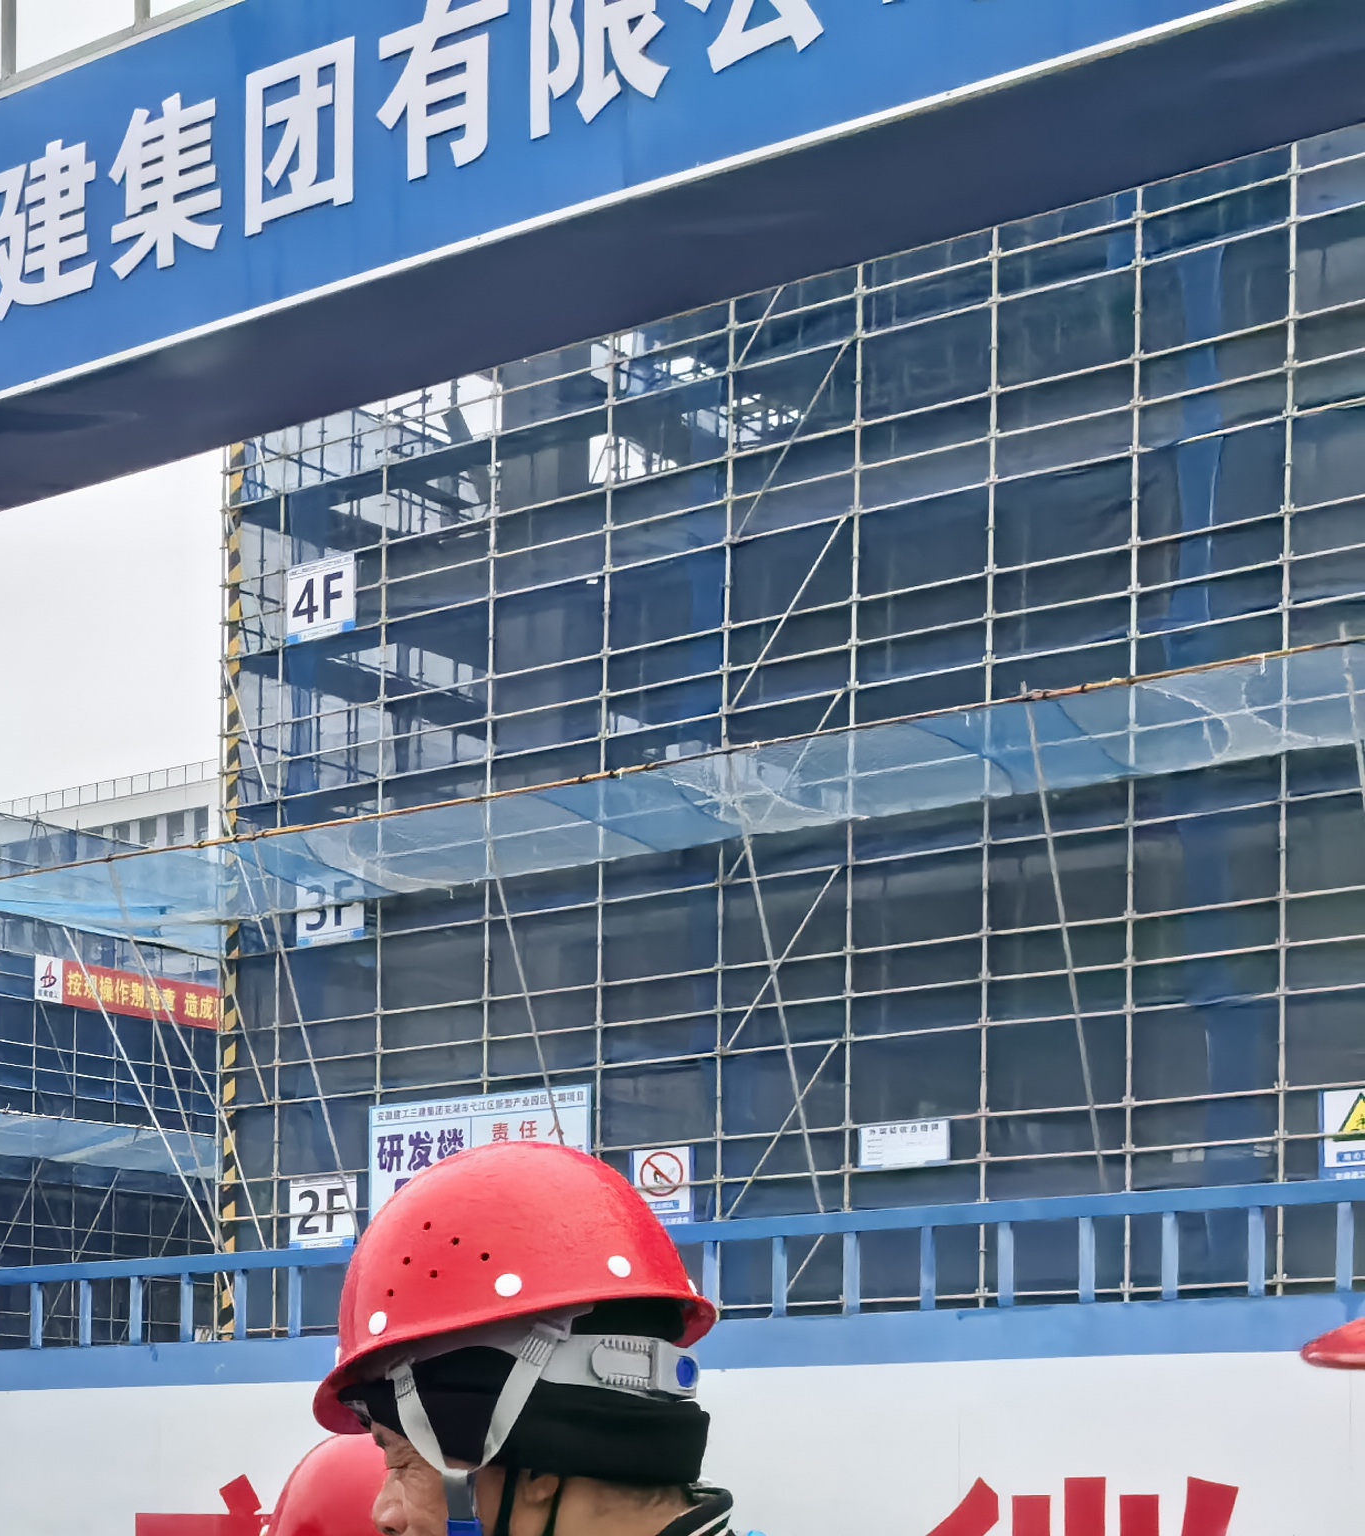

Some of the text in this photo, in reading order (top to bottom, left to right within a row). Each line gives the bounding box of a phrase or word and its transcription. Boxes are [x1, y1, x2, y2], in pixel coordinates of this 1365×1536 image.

[292, 571, 343, 624] 4F
[306, 880, 354, 931] 3F
[377, 1128, 465, 1173] 研发楼
[492, 1120, 565, 1142] 责任人
[297, 1188, 346, 1236] 2F
